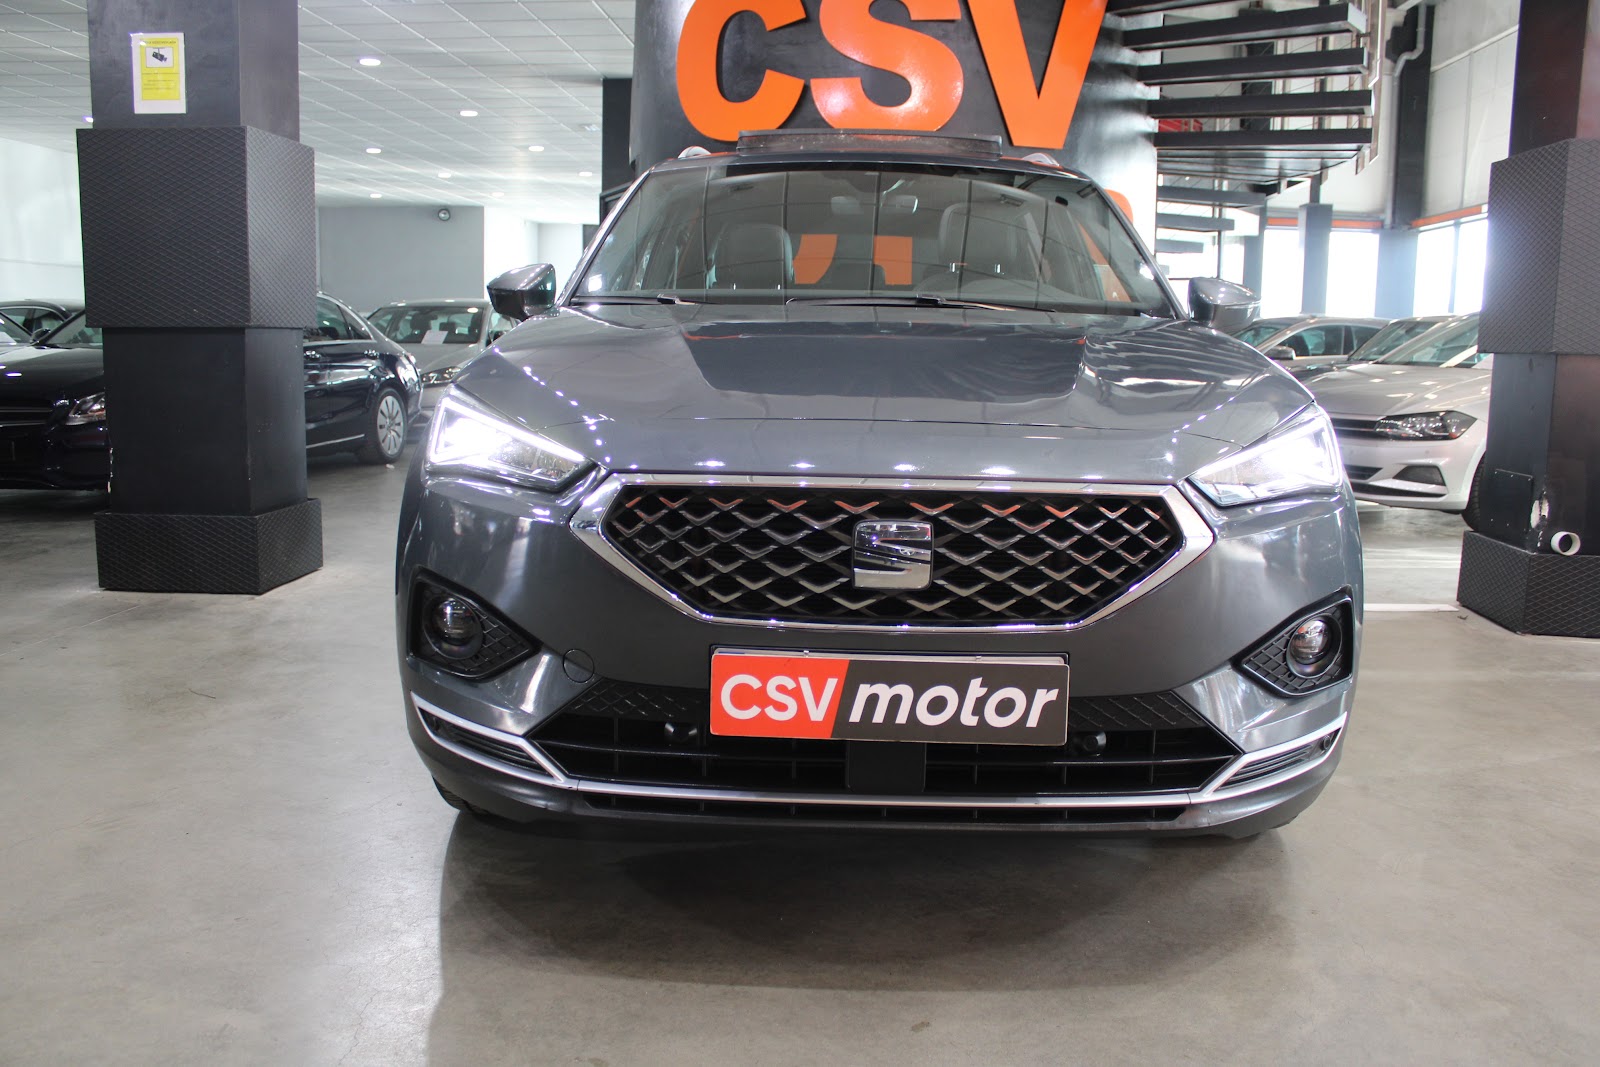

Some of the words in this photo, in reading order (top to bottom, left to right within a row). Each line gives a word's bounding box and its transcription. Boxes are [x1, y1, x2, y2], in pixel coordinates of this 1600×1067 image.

[676, 0, 1107, 149] CSV
[720, 673, 839, 722] CSV
[848, 676, 1060, 728] motor
